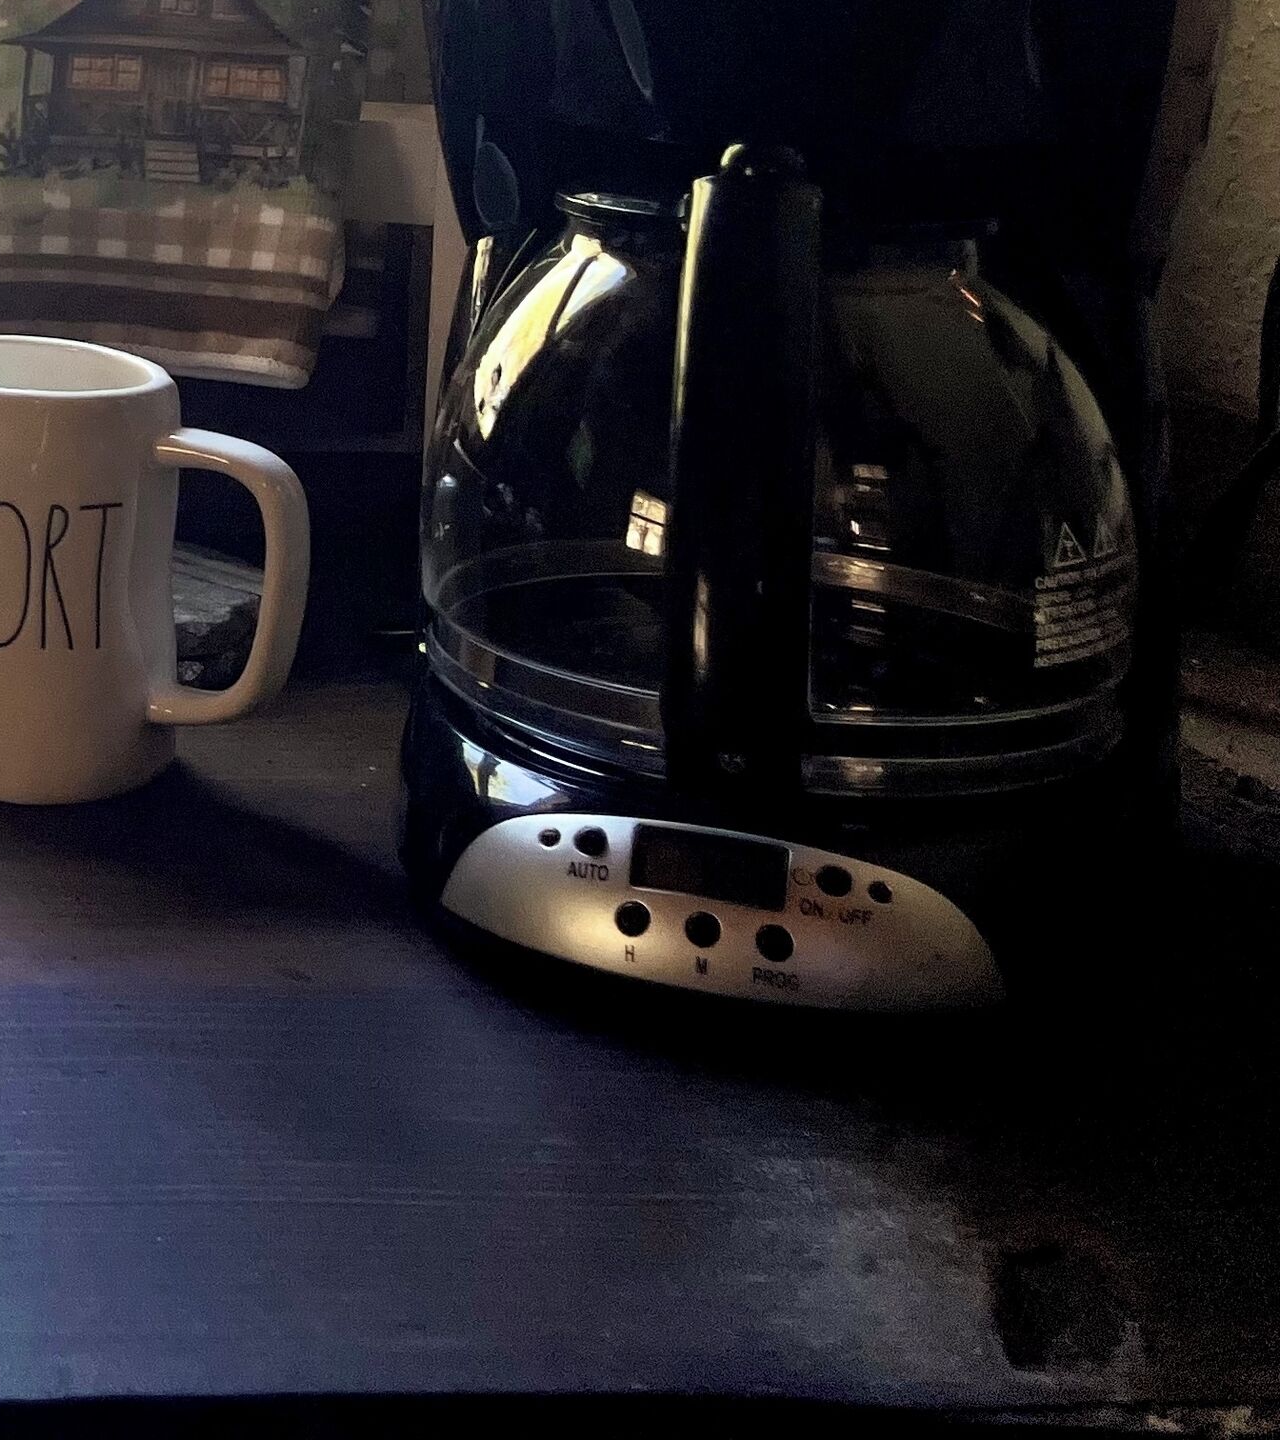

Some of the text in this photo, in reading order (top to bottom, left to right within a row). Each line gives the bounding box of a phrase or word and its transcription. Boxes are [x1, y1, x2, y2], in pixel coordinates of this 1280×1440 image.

[567, 861, 610, 882] AUTO
[624, 944, 636, 963] H
[752, 967, 801, 992] PROG
